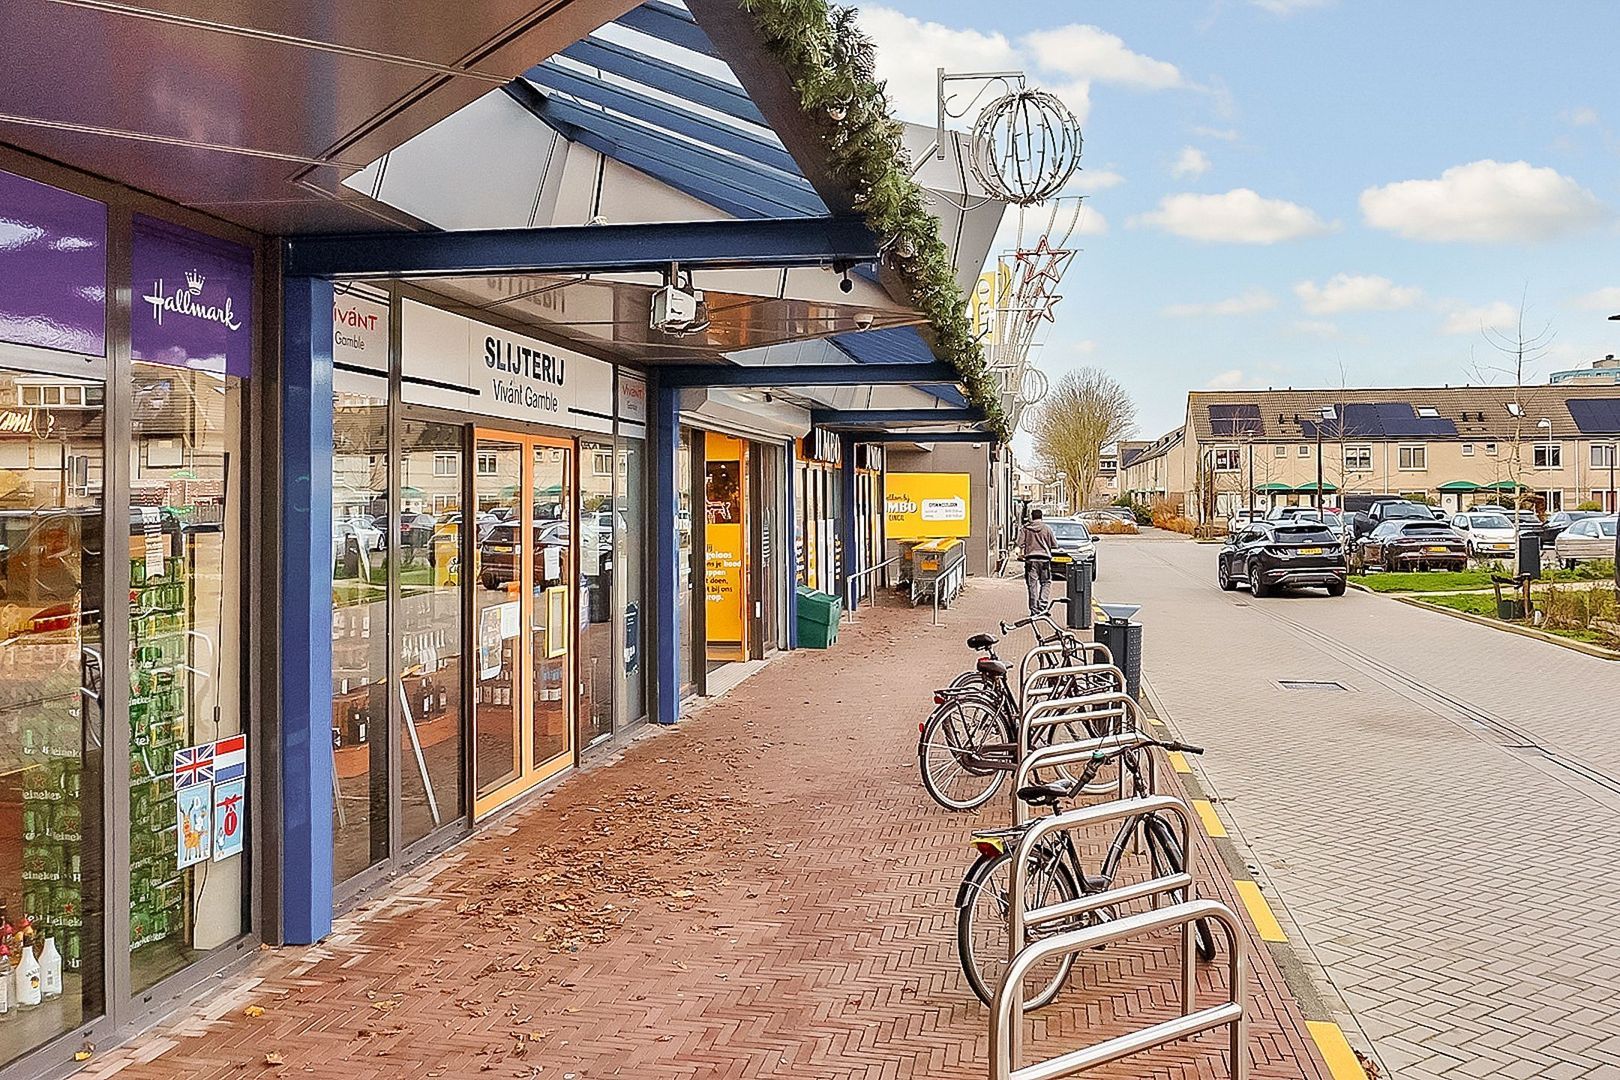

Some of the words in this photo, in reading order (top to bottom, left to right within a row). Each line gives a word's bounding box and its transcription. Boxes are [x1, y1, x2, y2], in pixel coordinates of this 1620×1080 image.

[142, 278, 242, 331] Hallmark
[334, 330, 365, 350] Gamble
[485, 336, 565, 386] SLIJTERIJ
[492, 378, 523, 406] Vivánt
[524, 386, 558, 412] Gamble
[886, 501, 918, 514] MBO
